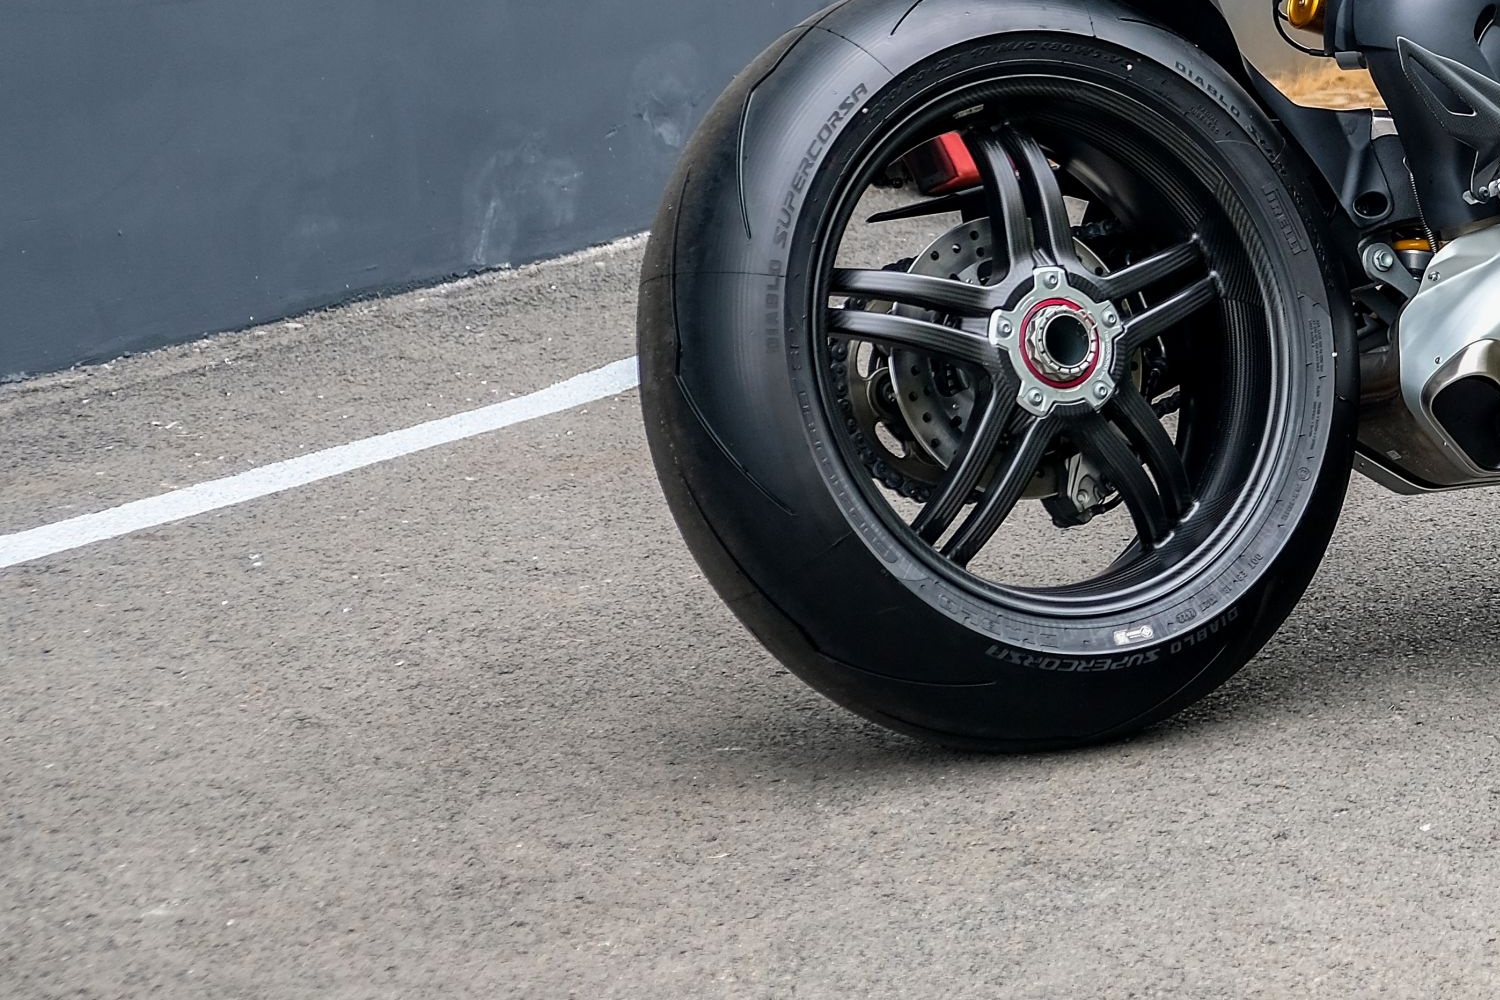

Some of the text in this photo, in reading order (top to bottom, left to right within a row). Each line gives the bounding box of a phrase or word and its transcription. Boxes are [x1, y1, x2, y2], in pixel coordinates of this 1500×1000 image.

[1174, 60, 1241, 118] DIABLO
[765, 82, 868, 353] DIABLO SUPERCORSA
[1170, 606, 1239, 655] DIABLO
[985, 644, 1161, 673] SUPERCORSA
